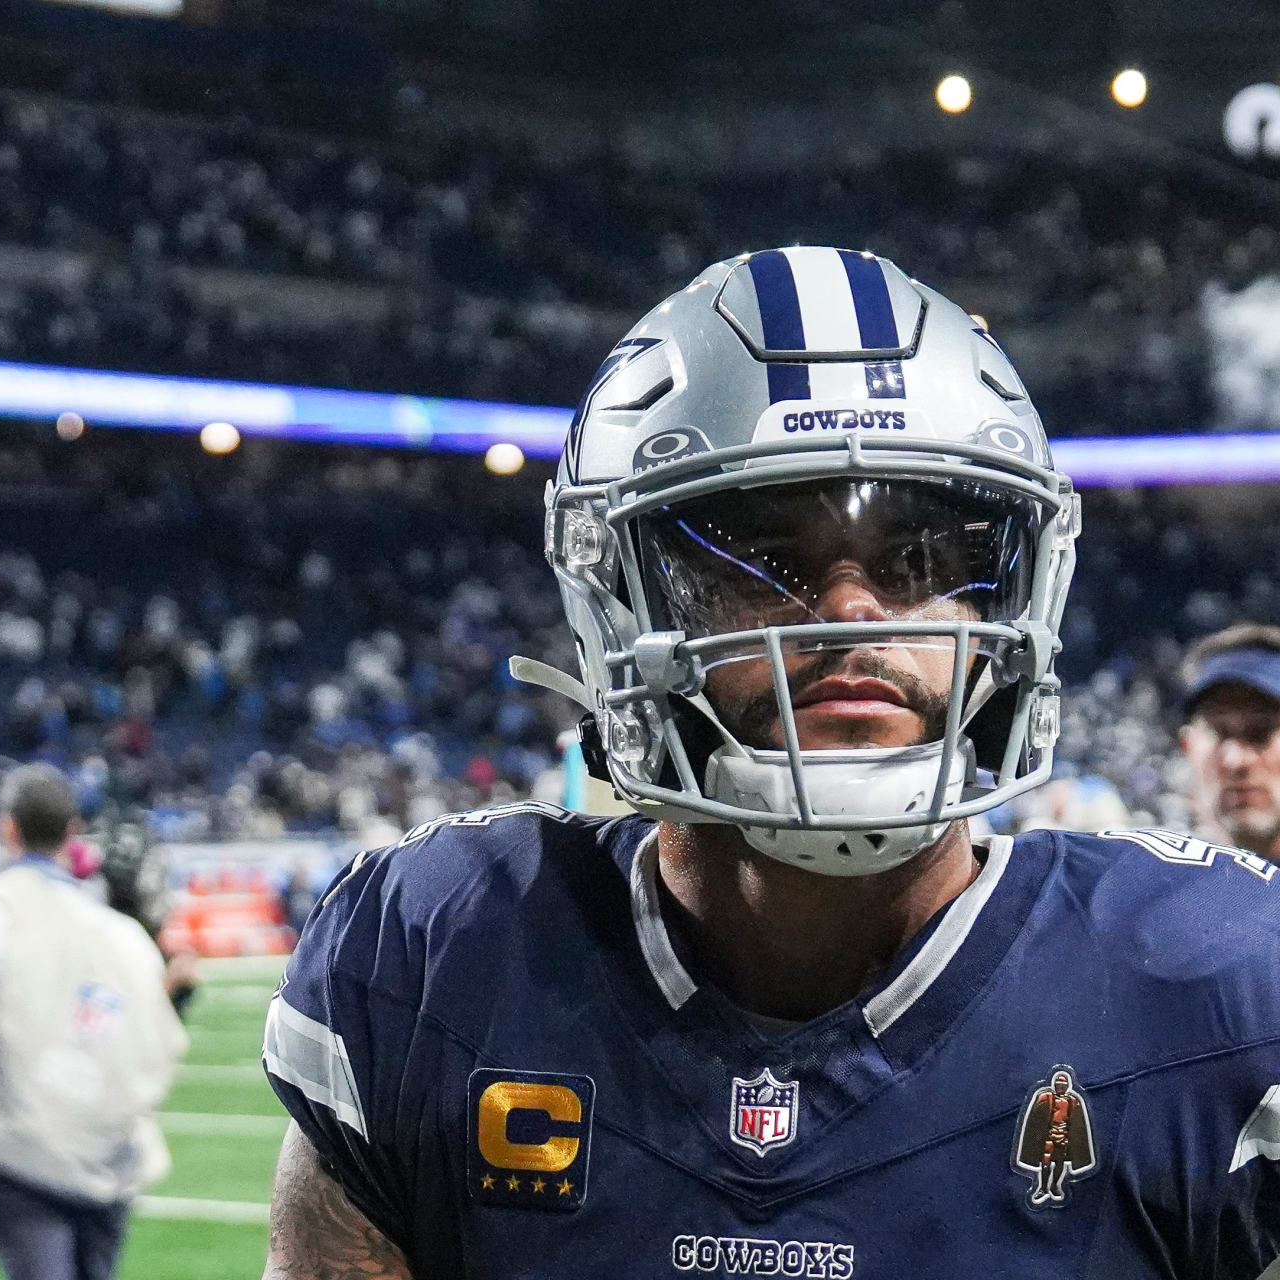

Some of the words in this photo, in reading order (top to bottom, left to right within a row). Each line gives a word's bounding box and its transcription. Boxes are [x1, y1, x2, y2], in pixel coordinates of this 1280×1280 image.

[783, 409, 906, 433] COWBOYS
[740, 1107, 786, 1141] NFL
[671, 1234, 855, 1280] COWBOYS
